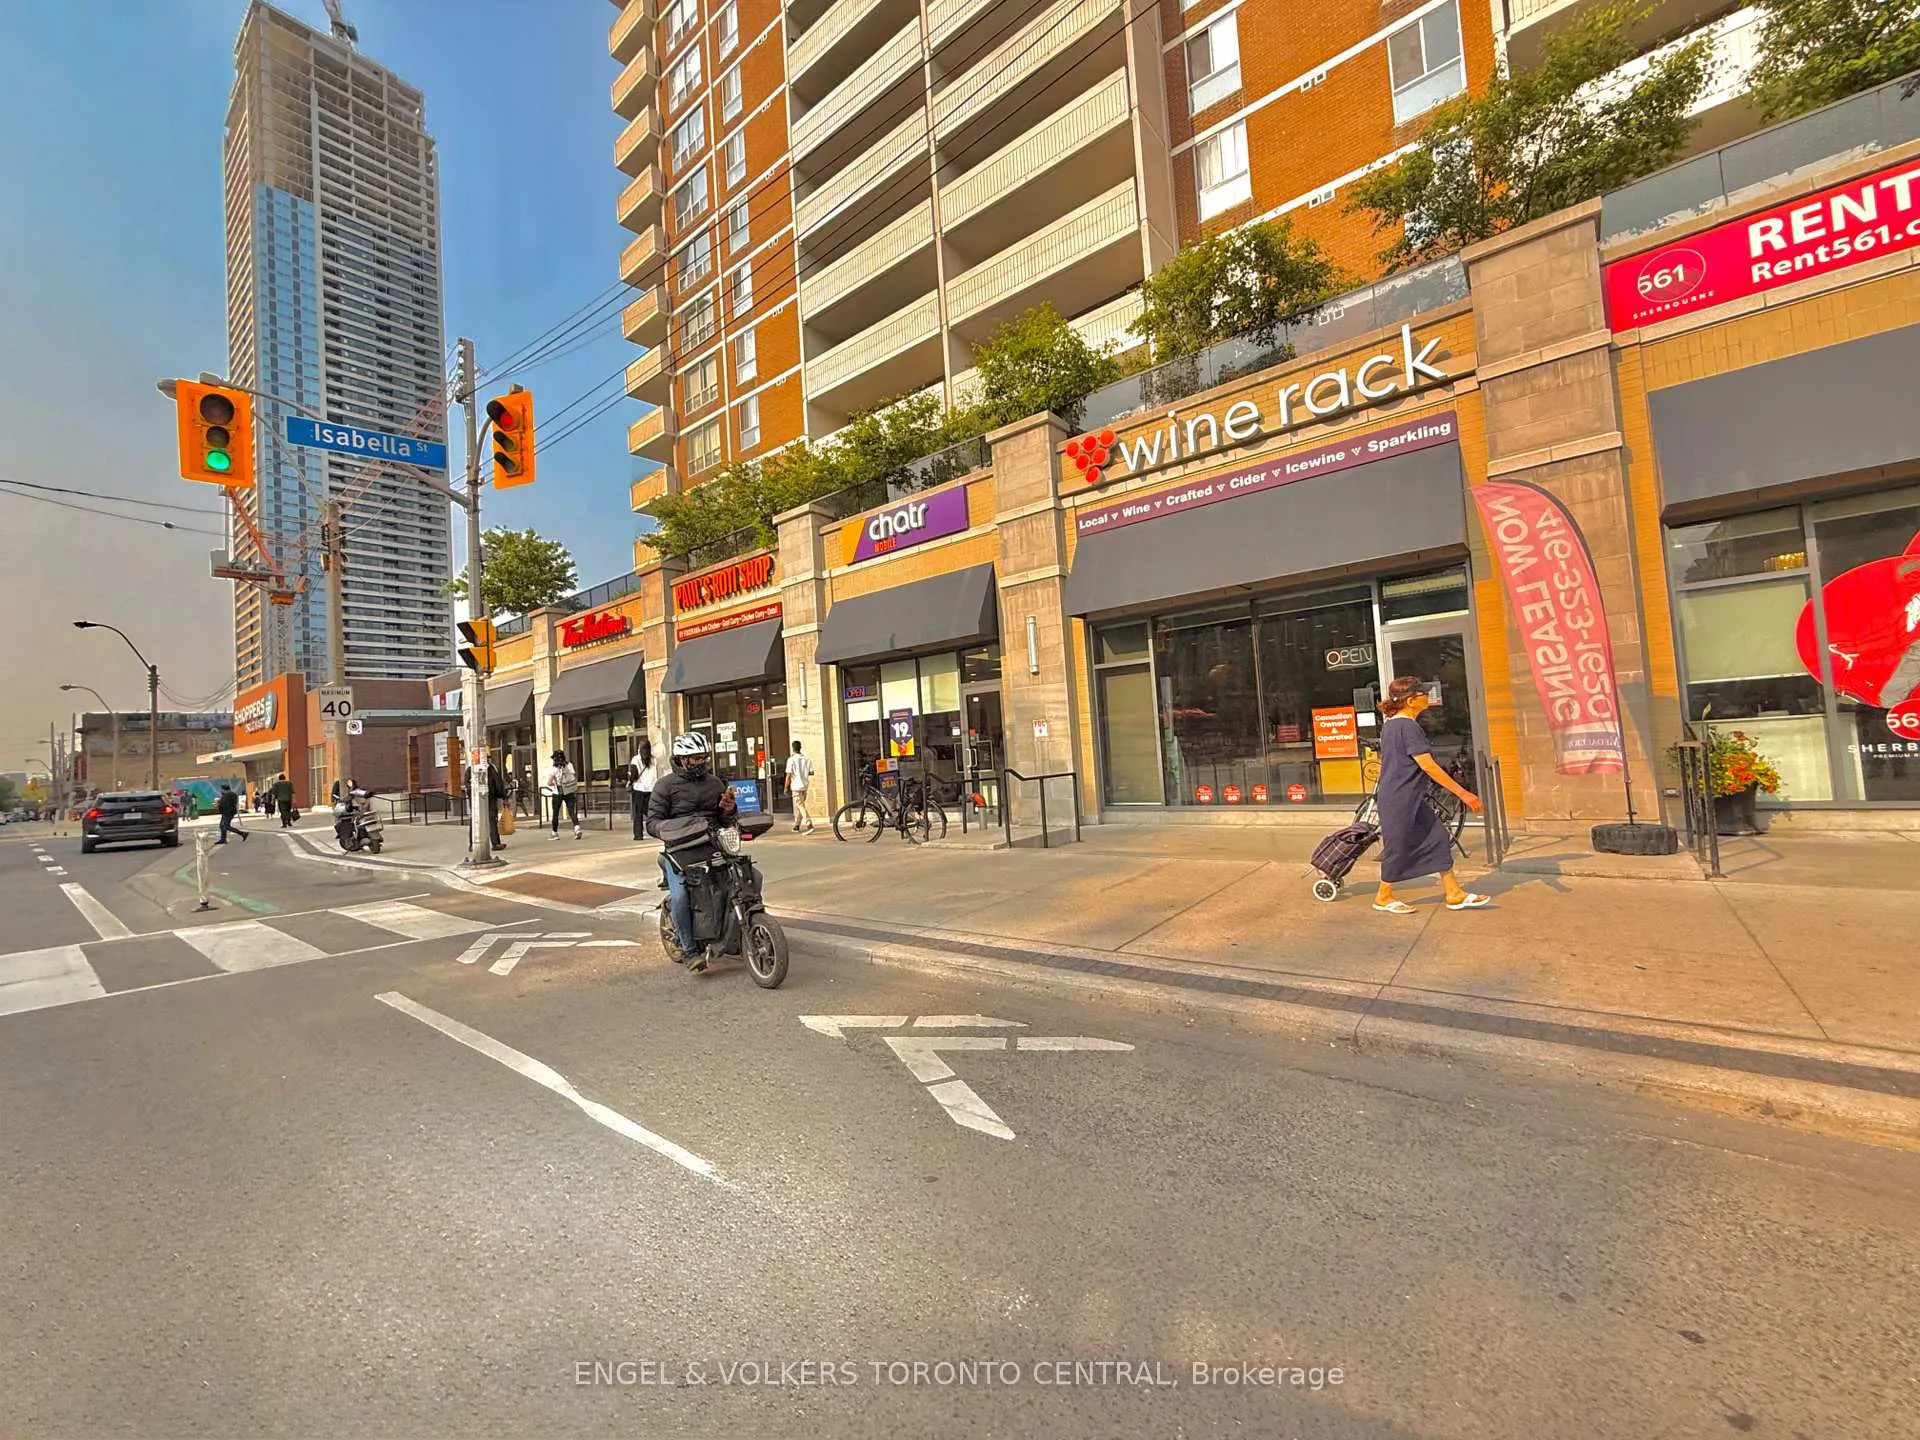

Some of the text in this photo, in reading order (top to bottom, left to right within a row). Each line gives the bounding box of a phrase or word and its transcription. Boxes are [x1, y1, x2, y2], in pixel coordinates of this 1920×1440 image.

[1748, 168, 1920, 257] RENT
[1637, 263, 1685, 295] 561
[1633, 290, 1715, 320] SHERBOURNE
[1118, 323, 1447, 474] wine rack
[314, 422, 429, 457] Isabella St
[1079, 419, 1452, 531] Local Wine Crafted Cider Icewine Sparkling
[868, 502, 928, 541] chatr
[740, 554, 771, 590] SHOP
[1326, 646, 1373, 665] OPEN
[847, 686, 866, 698] OPEN
[234, 697, 265, 726] SHOPPERS
[322, 701, 352, 717] 40
[1315, 712, 1353, 721] Canadian
[1319, 720, 1348, 728] Owned
[1317, 733, 1354, 743] Operated
